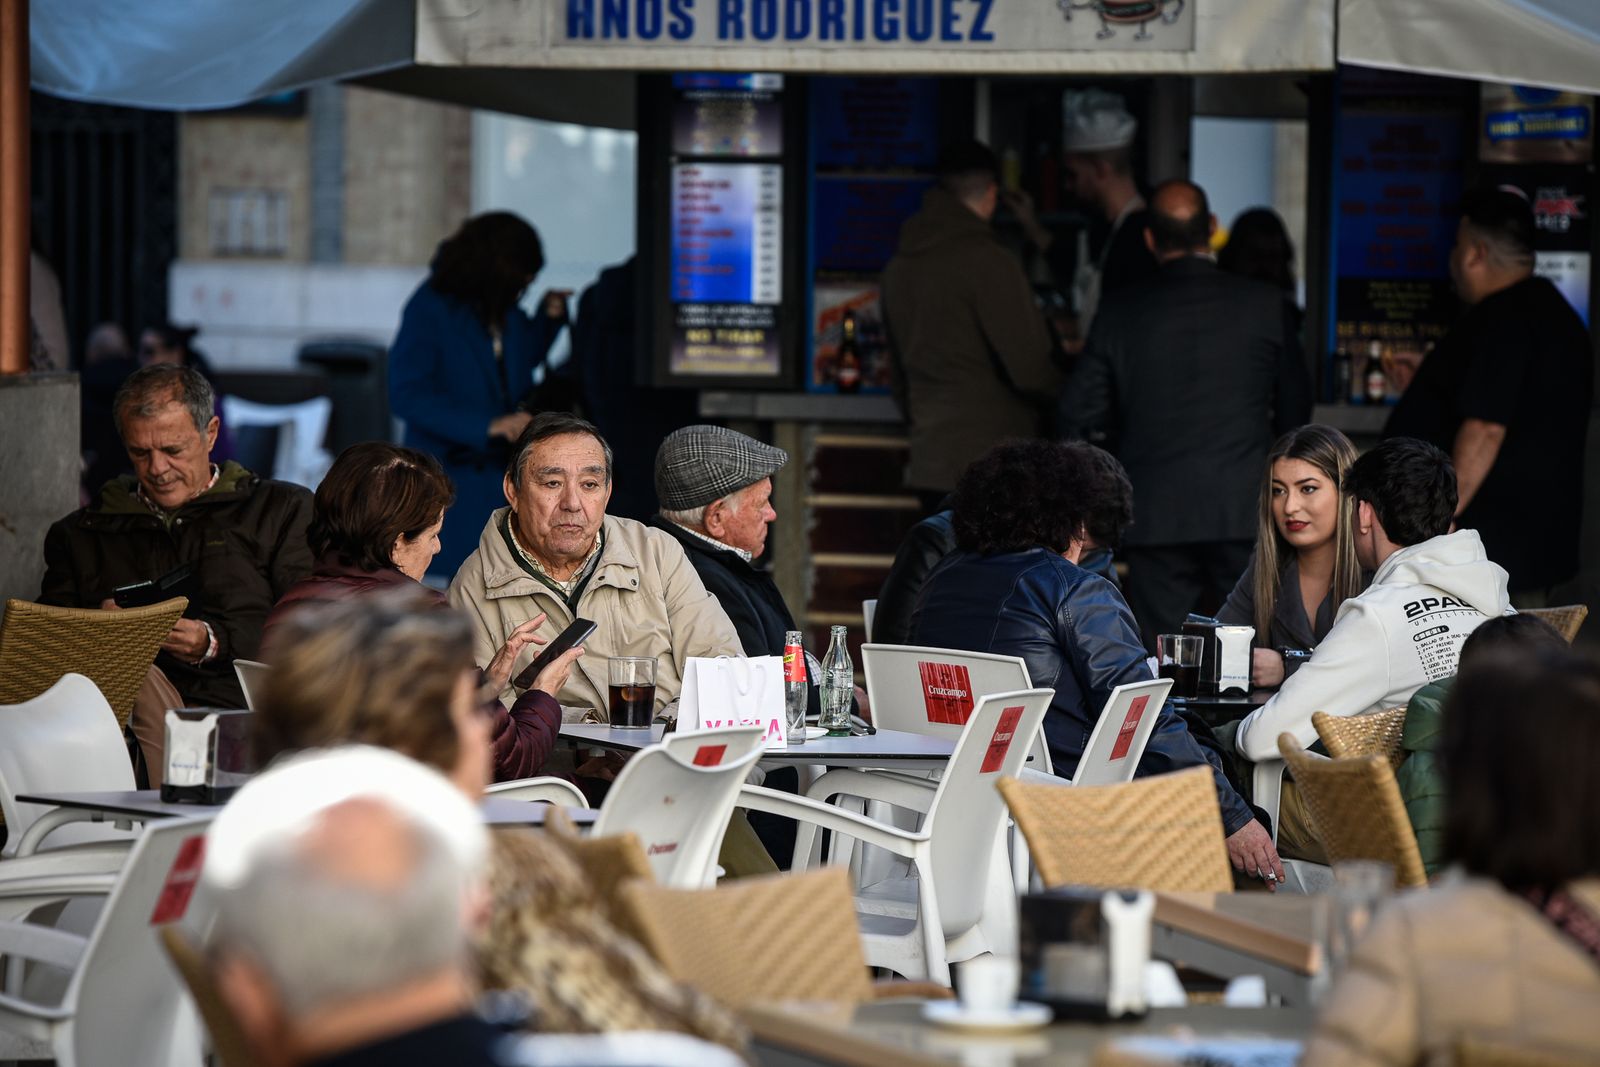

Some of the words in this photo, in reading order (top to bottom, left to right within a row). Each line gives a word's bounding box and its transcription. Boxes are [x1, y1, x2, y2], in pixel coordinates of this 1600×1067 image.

[566, 0, 694, 40] HNOS
[717, 0, 995, 42] RODRIGUEZ
[928, 684, 967, 699] Cruzcampo
